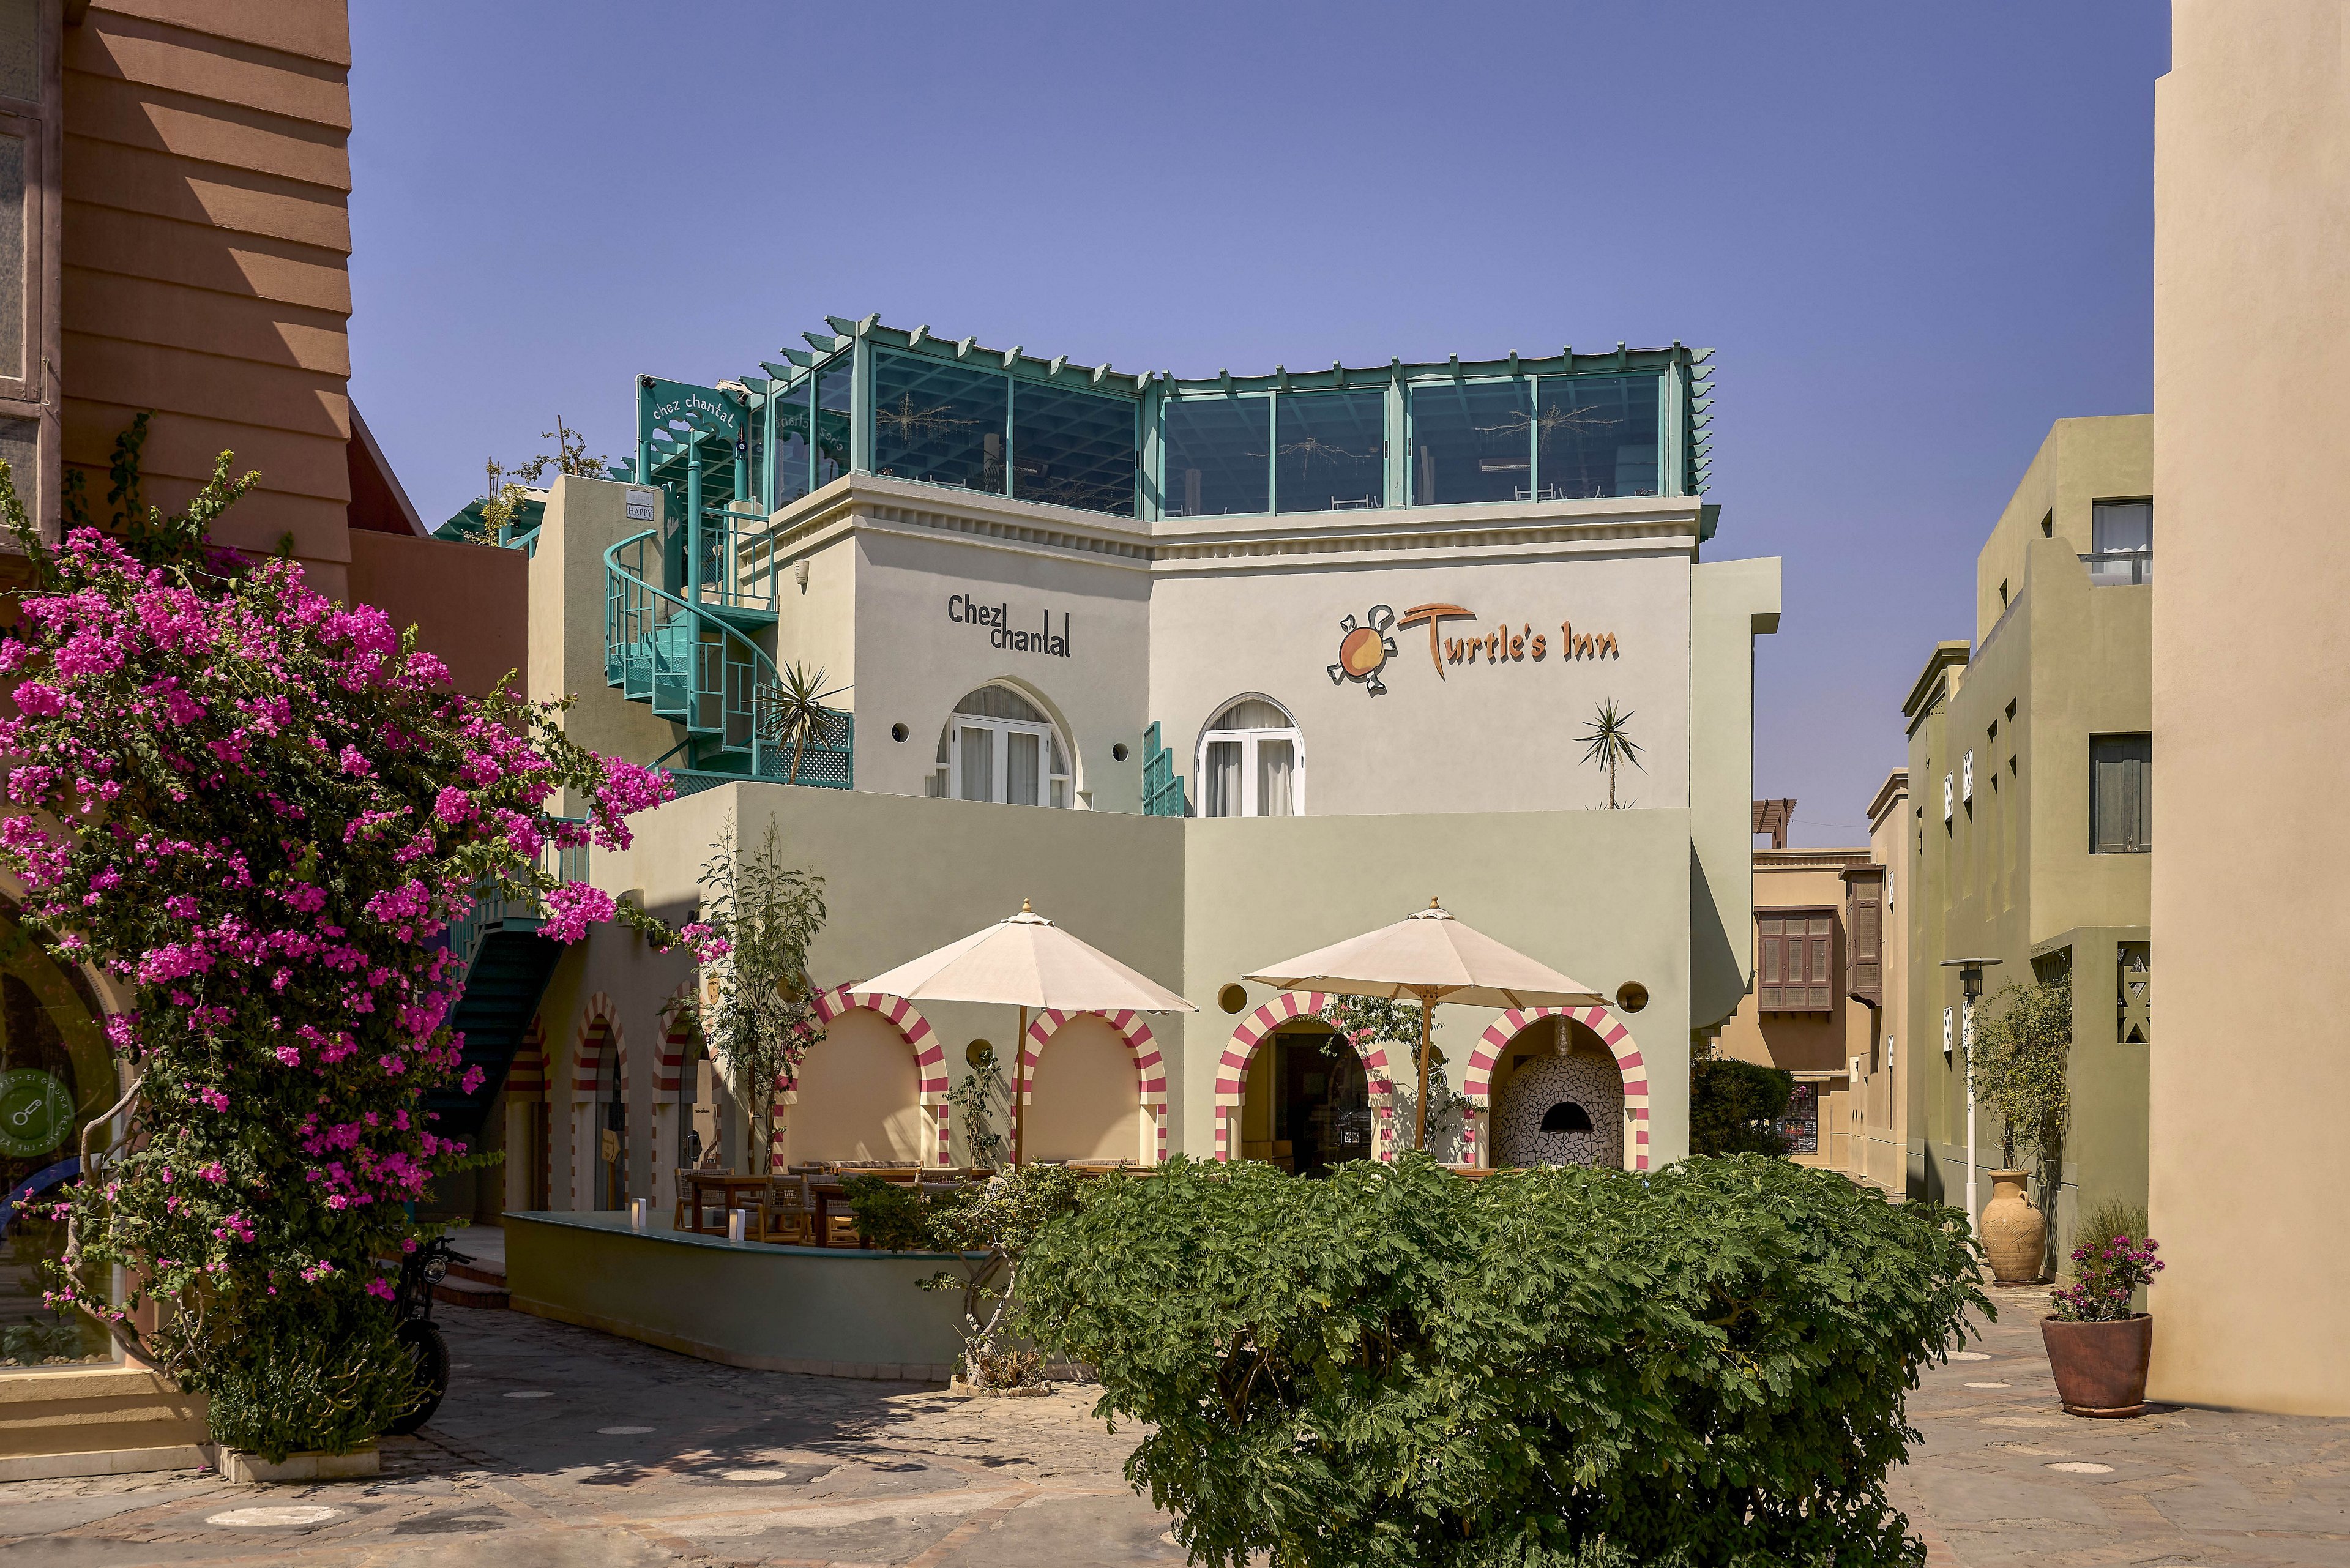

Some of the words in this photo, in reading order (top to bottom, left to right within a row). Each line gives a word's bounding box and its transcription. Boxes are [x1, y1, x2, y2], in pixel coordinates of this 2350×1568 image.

[653, 401, 681, 420] chez
[628, 506, 652, 517] HAPPY
[948, 594, 1002, 627] Chez
[990, 603, 1071, 658] chantal
[1396, 602, 1547, 683] Turtle's
[1560, 620, 1620, 662] Inn
[41, 1078, 69, 1109] GOUNA
[45, 1114, 69, 1146] RESALE
